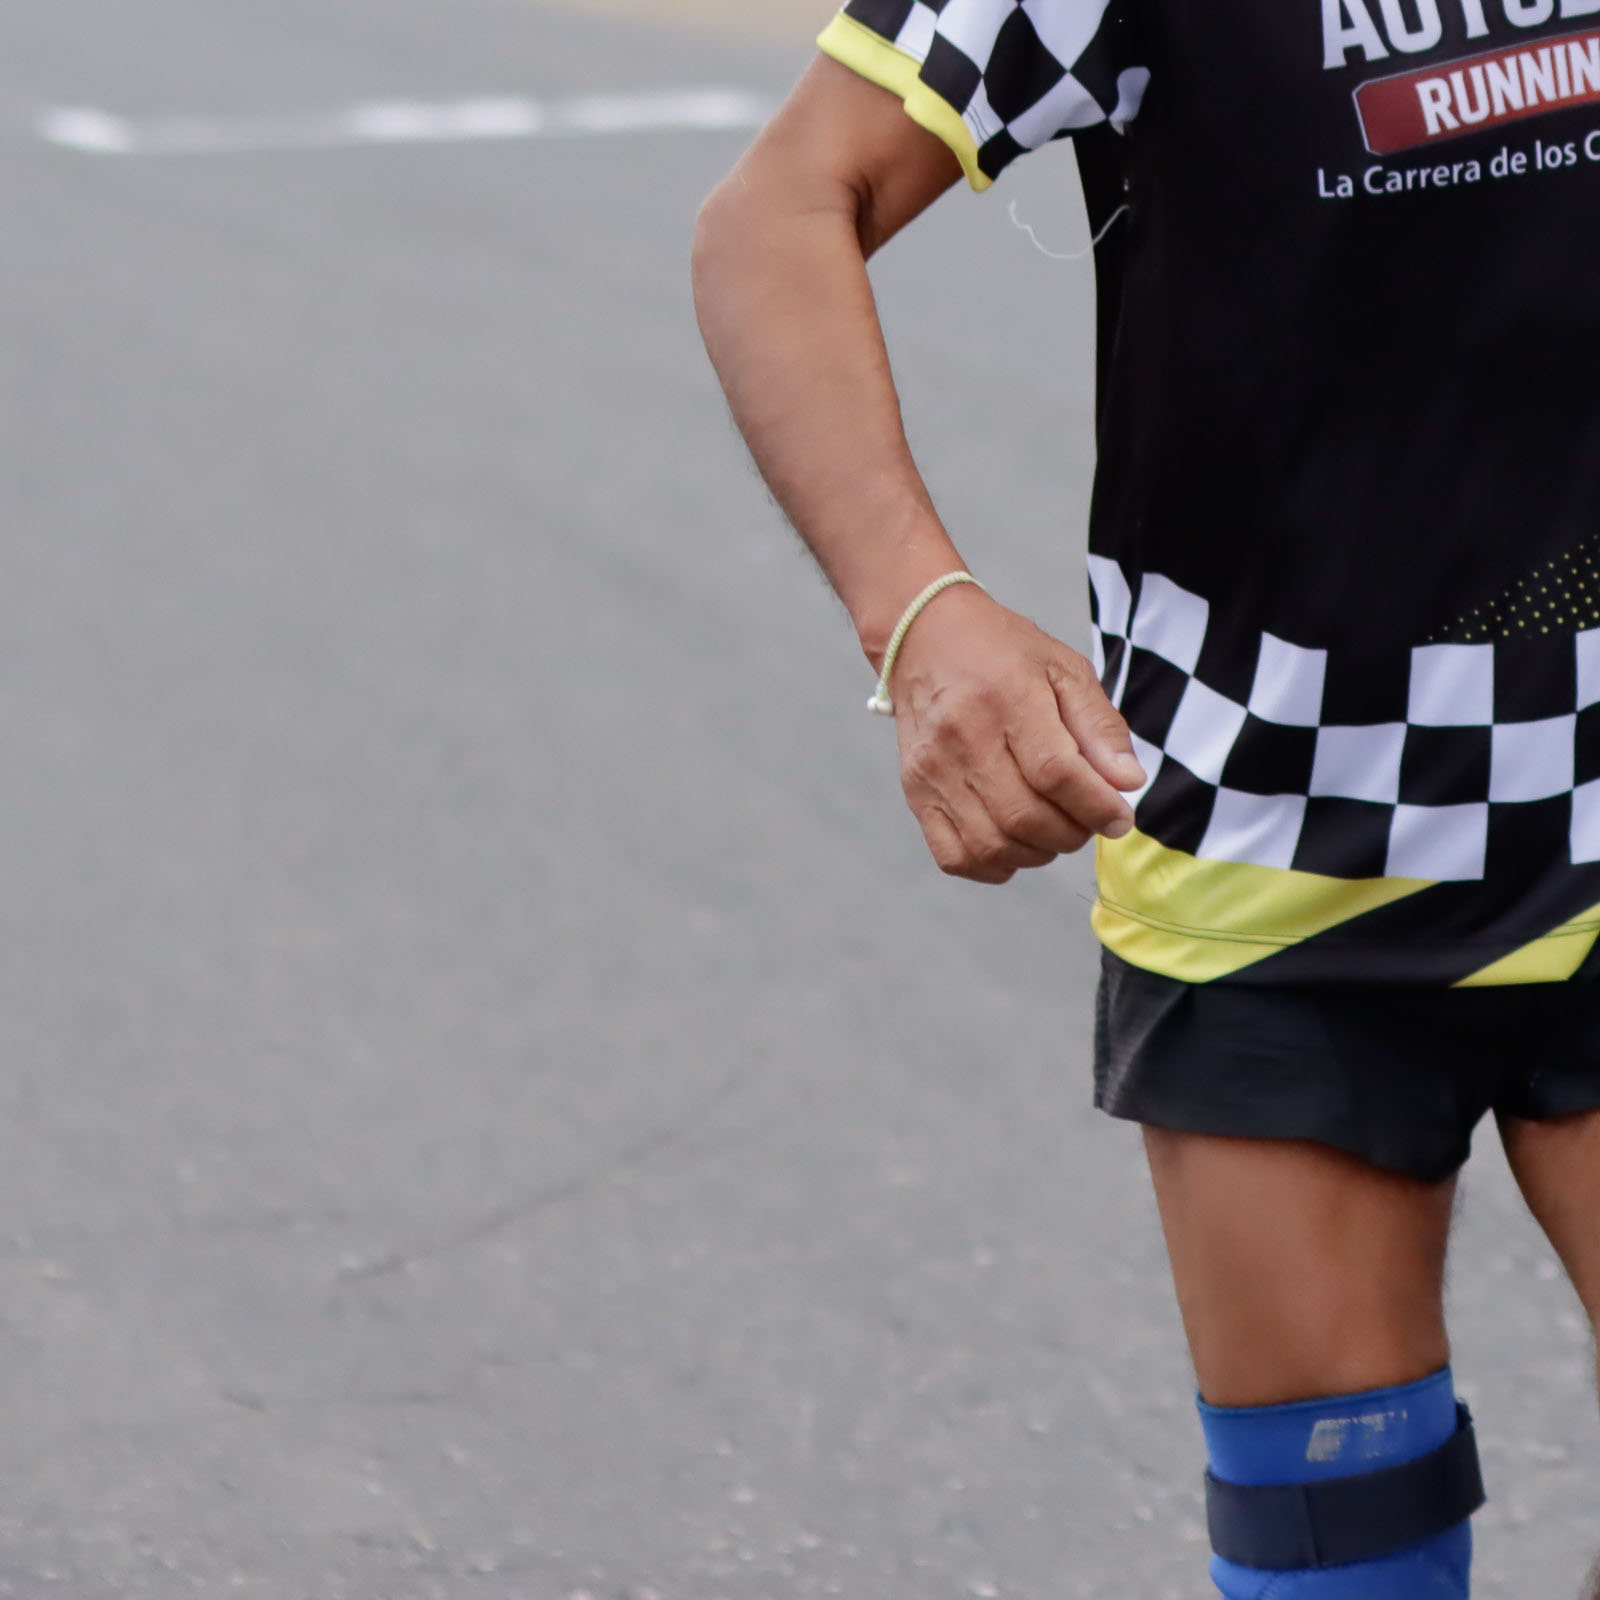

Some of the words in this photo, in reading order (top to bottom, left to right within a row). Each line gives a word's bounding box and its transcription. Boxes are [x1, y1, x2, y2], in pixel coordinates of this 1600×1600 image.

[1317, 168, 1354, 199] La
[1363, 156, 1482, 196] Carrera
[1490, 146, 1528, 179] de
[1536, 140, 1577, 171] los
